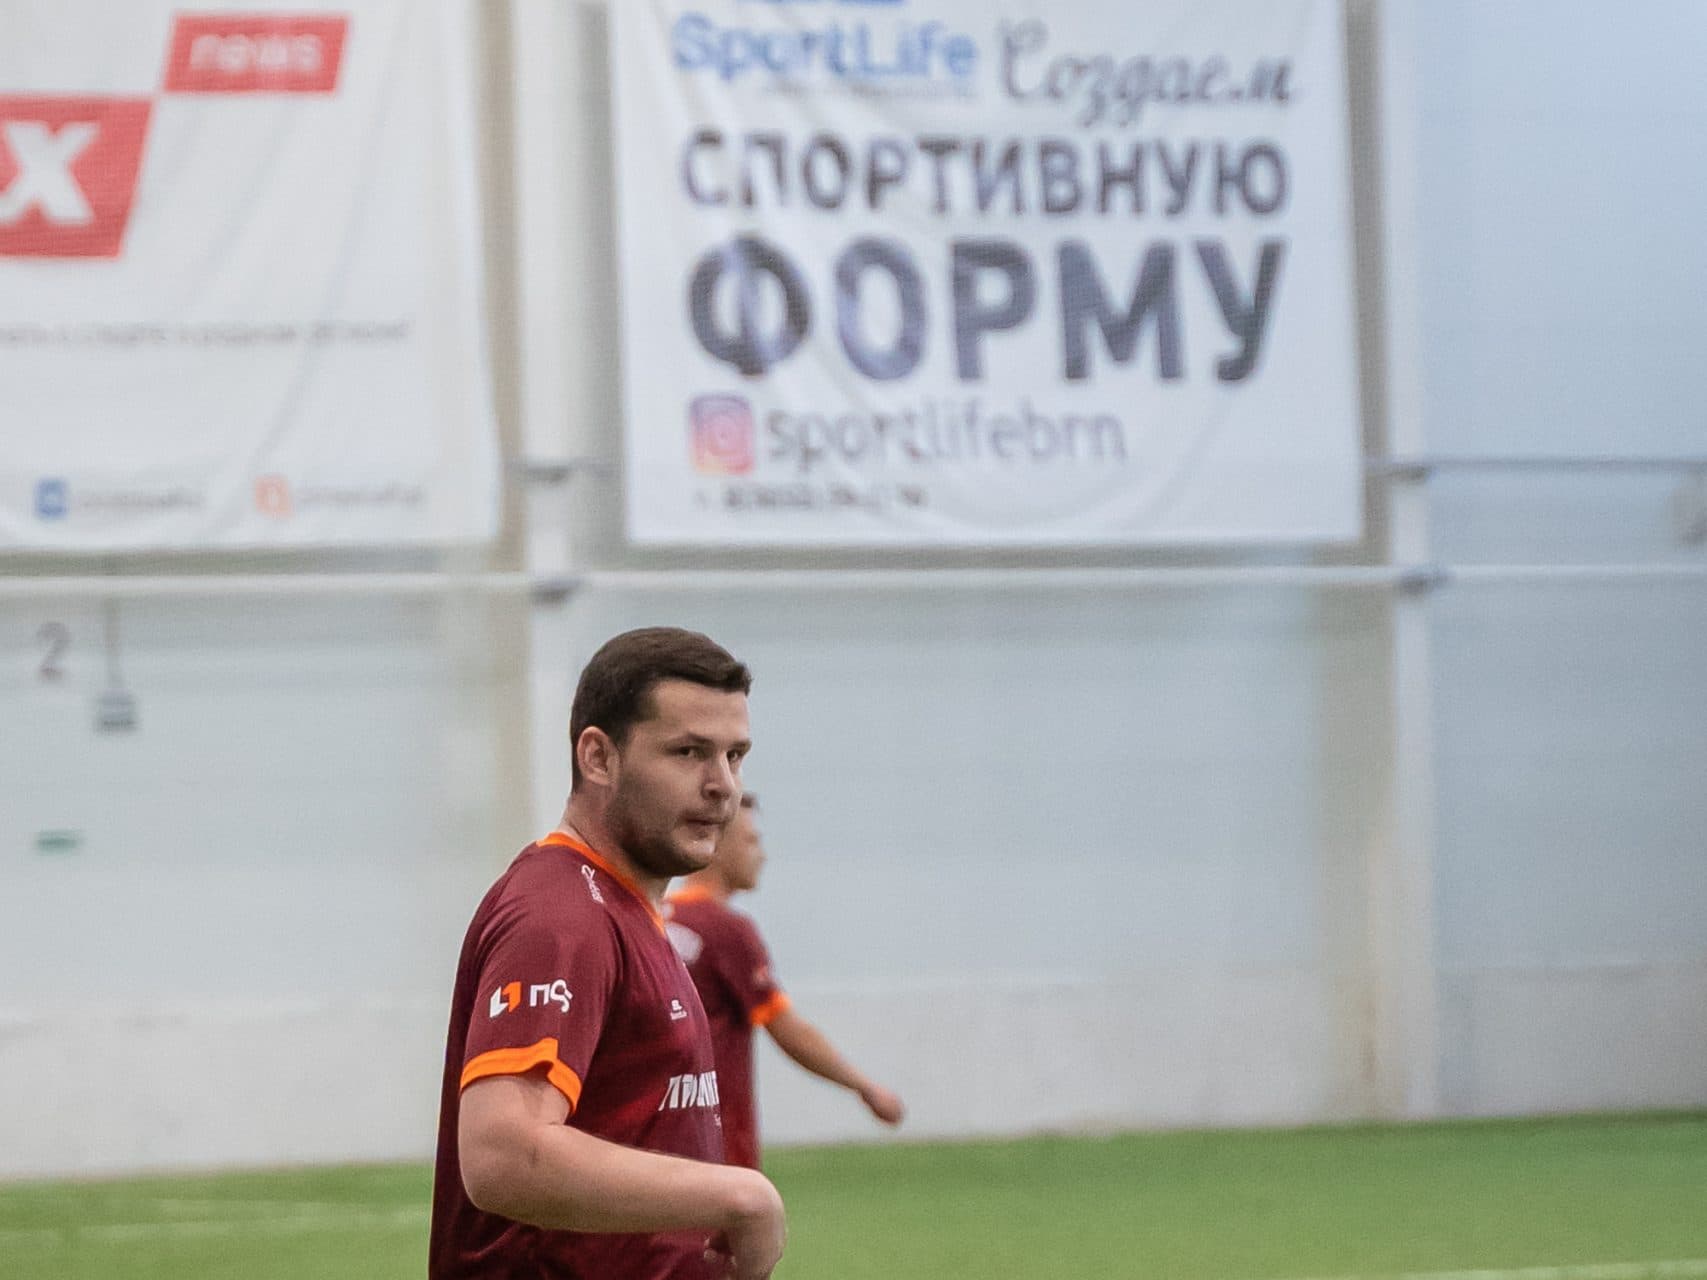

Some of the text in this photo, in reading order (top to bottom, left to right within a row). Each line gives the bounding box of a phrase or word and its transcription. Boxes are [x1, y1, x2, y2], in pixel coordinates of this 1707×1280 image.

[672, 12, 978, 81] SportLife
[683, 131, 1289, 216] СПОРТИВНУЮ
[687, 234, 1287, 382] ФОРМУ
